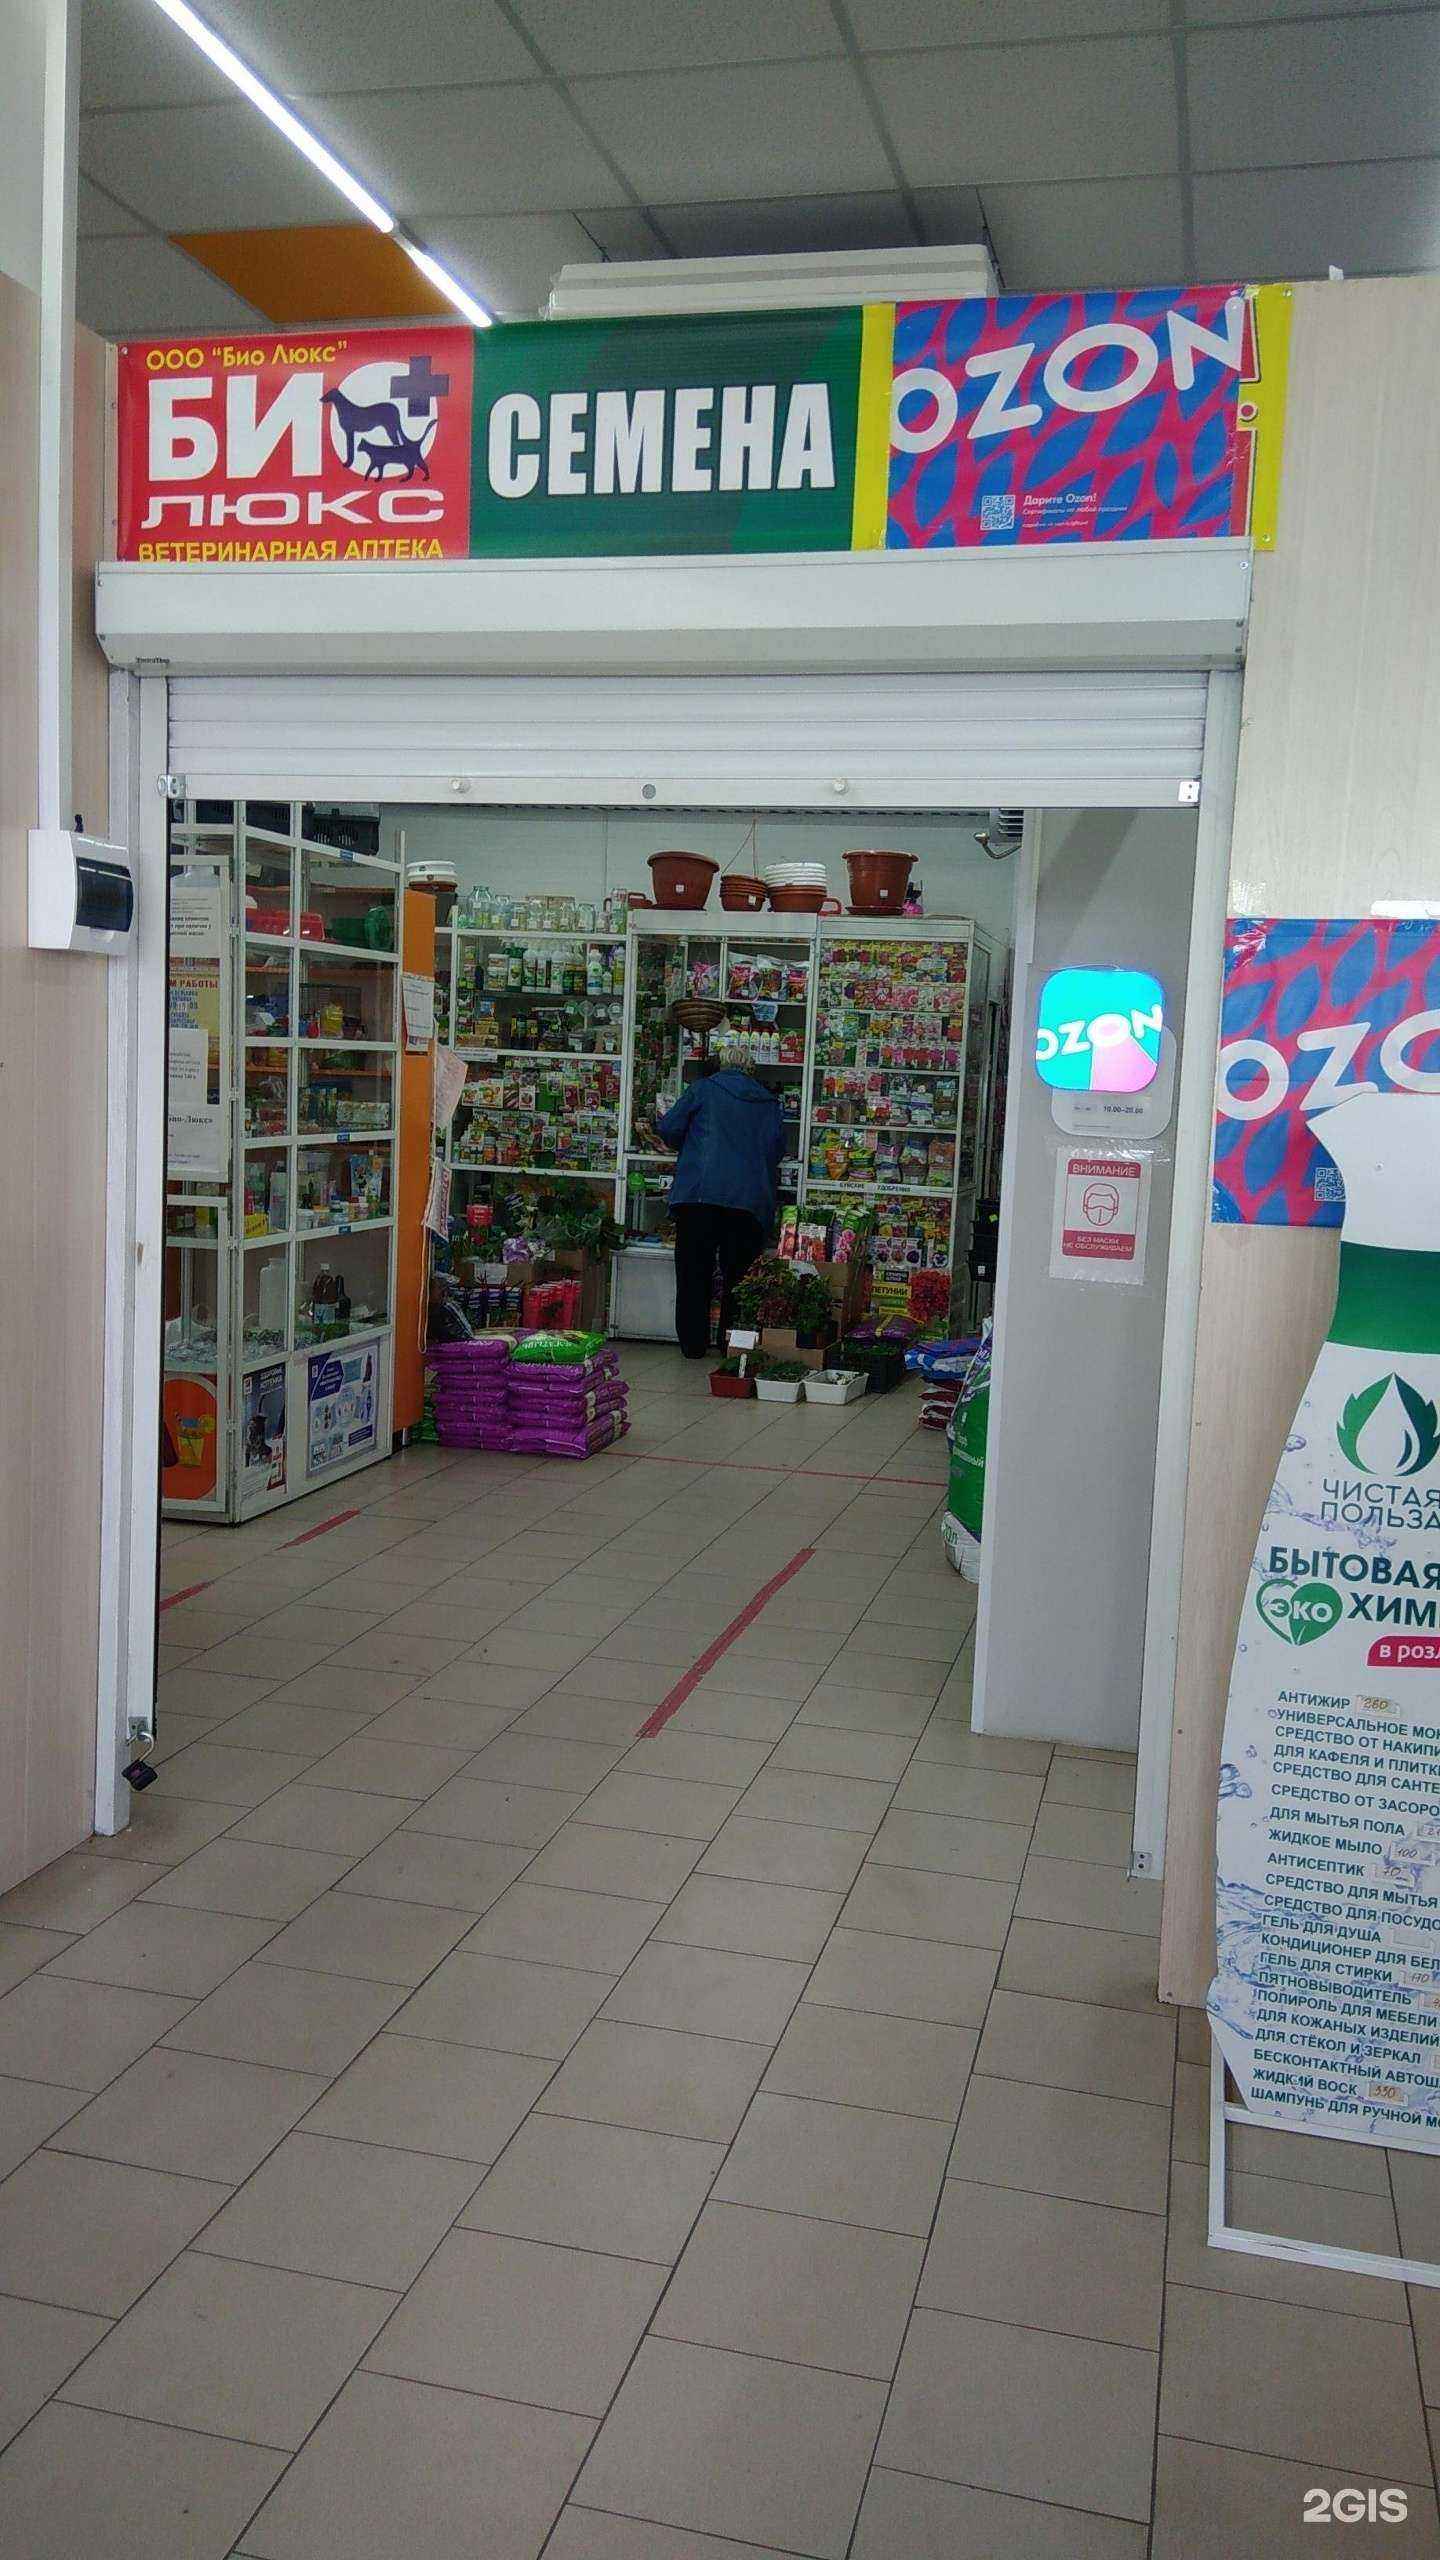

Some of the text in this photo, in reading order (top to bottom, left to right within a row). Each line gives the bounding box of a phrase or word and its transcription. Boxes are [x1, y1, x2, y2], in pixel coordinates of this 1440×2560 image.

[146, 348, 204, 370] ООО
[890, 297, 1244, 454] OZON
[488, 382, 835, 499] СЕМЕНА
[141, 489, 445, 529] ЛЮКС
[1023, 494, 1063, 507] Дарите
[138, 538, 444, 563] ВЕТЕРИНАРНАЯ АПТЕКА
[180, 980, 218, 988] РАБОТЫ
[1036, 1003, 1163, 1061] OZON
[1072, 1163, 1137, 1177] ВНИМАНИЕ
[1322, 1477, 1440, 1509] ЧИСТАЯ
[1320, 1501, 1440, 1530] ПОЛЬЗА
[1268, 1546, 1440, 1591] БЫТОВАЯ
[1269, 1598, 1333, 1623] ЭКО
[1347, 1592, 1440, 1629] ХИМ
[1278, 1690, 1350, 1709] АНТИЖИР
[1275, 1725, 1354, 1746] СРЕДСТВО
[1359, 1736, 1378, 1749] ОТ
[1277, 1708, 1408, 1736] УНИВЕРСАЛЬНОЕ
[1274, 1744, 1304, 1758] ДЛЯ
[1308, 1747, 1370, 1767] КАФЕЛЯ
[1374, 1757, 1384, 1769] И
[1272, 1761, 1352, 1783] СРЕДСТВО
[1355, 1772, 1387, 1787] ДЛЯ
[1271, 1783, 1440, 1817] СРЕДСТВО ОТ ЗАСОРО
[1269, 1806, 1405, 1836] ДЛЯ МЫТЬЯ ПОЛА
[1268, 1828, 1382, 1855] ЖИДКОЕ МЫЛО
[1267, 1852, 1365, 1877] АНТИСЕПТИК
[1265, 1873, 1438, 1908] СРЕДСТВО ДЛЯ МЫТЬЯ
[1262, 1914, 1382, 1943] ГЕЛЬ ДЛЯ ДУША
[1264, 1894, 1440, 1931] СРЕДСТВО ДЛЯ ПОСУДО
[1260, 1951, 1392, 1983] ГЕЛЬ ДЛЯ СТИРКИ
[1261, 1933, 1440, 1971] КОНДИЦИОНЕР ДЛЯ БЕЛ
[1258, 1971, 1412, 2006] ПЯТНОВЫВОДИТЕЛЬ
[1258, 1989, 1437, 2028] ПОЛИРОЛЬ ДЛЯ МЕБЕЛИ
[1256, 2008, 1440, 2047] ДЛЯ КОЖАНЫХ ИЗДЕЛИЙ
[1255, 2028, 1285, 2043] ДЛЯ
[1351, 2043, 1361, 2055] И
[1364, 2045, 1421, 2064] ЗЕРКАЛ
[1253, 2049, 1440, 2088] БЕСКОНТАКТНЫЙ АВТОШ
[1253, 2068, 1357, 2095] ЖИДКИЙ ВОСК
[1251, 2087, 1440, 2128] ШАМПУНЬ ДЛЯ РУЧНОЙ М
